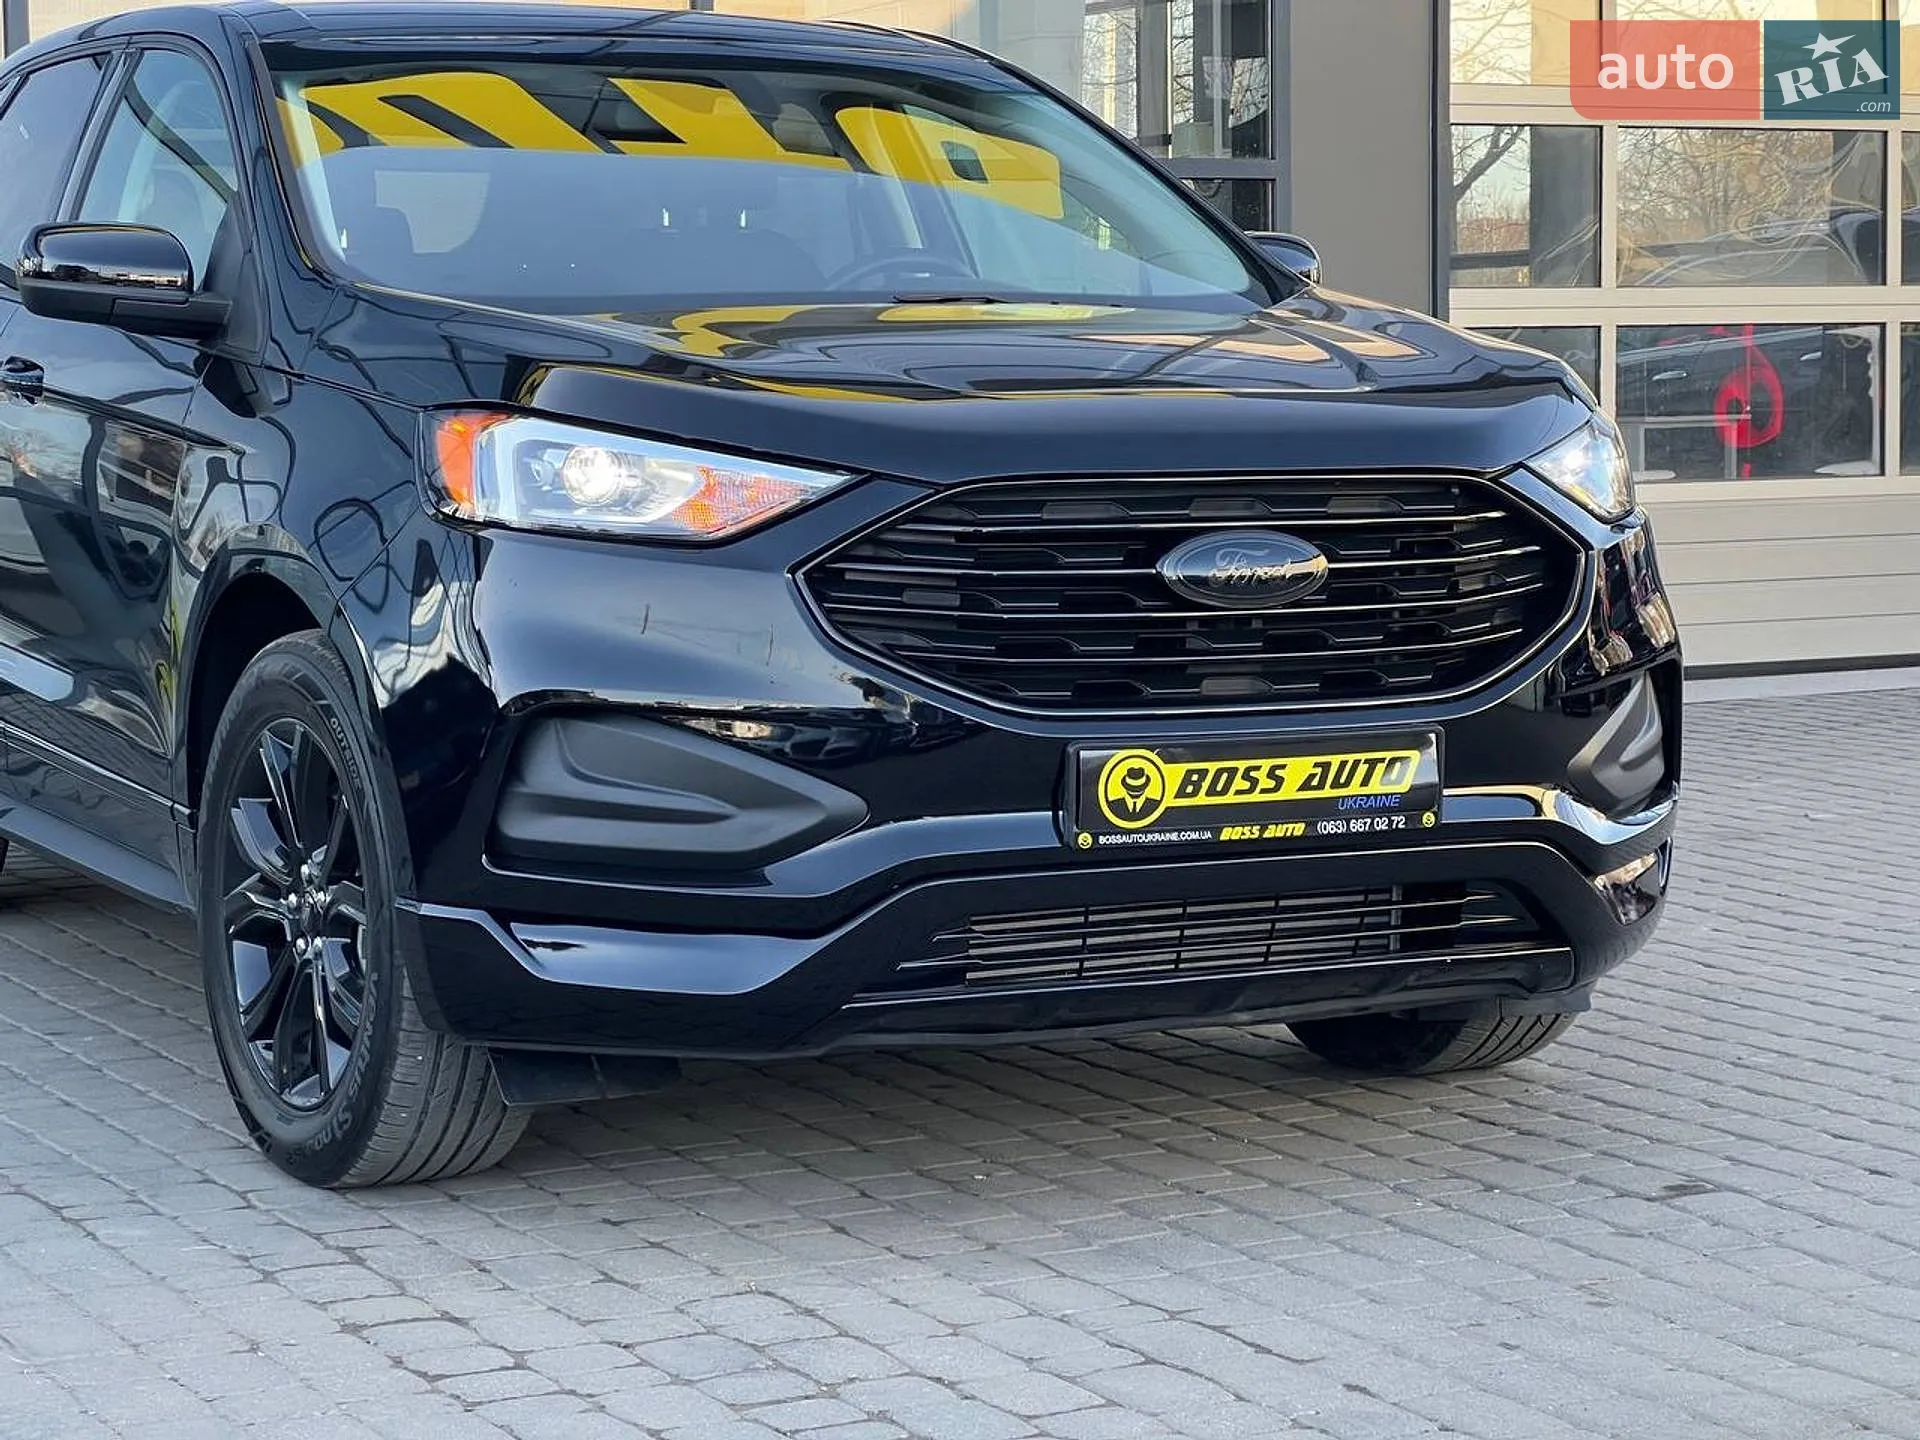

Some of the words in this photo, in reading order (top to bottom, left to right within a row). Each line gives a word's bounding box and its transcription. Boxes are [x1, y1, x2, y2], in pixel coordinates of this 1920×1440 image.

[1209, 547, 1291, 588] Ford
[1173, 763, 1287, 799] BOSS
[1296, 756, 1412, 792] AUTO
[1338, 795, 1400, 810] UKRAINE
[1219, 825, 1261, 841] BOSS
[1262, 822, 1306, 839] AUTO
[1317, 820, 1347, 834] (063)
[1350, 819, 1370, 833] 667
[1373, 817, 1388, 831] 02
[1391, 815, 1406, 829] 72
[1098, 830, 1212, 845] BOSSAUTOUKRAINE.COM.UA
